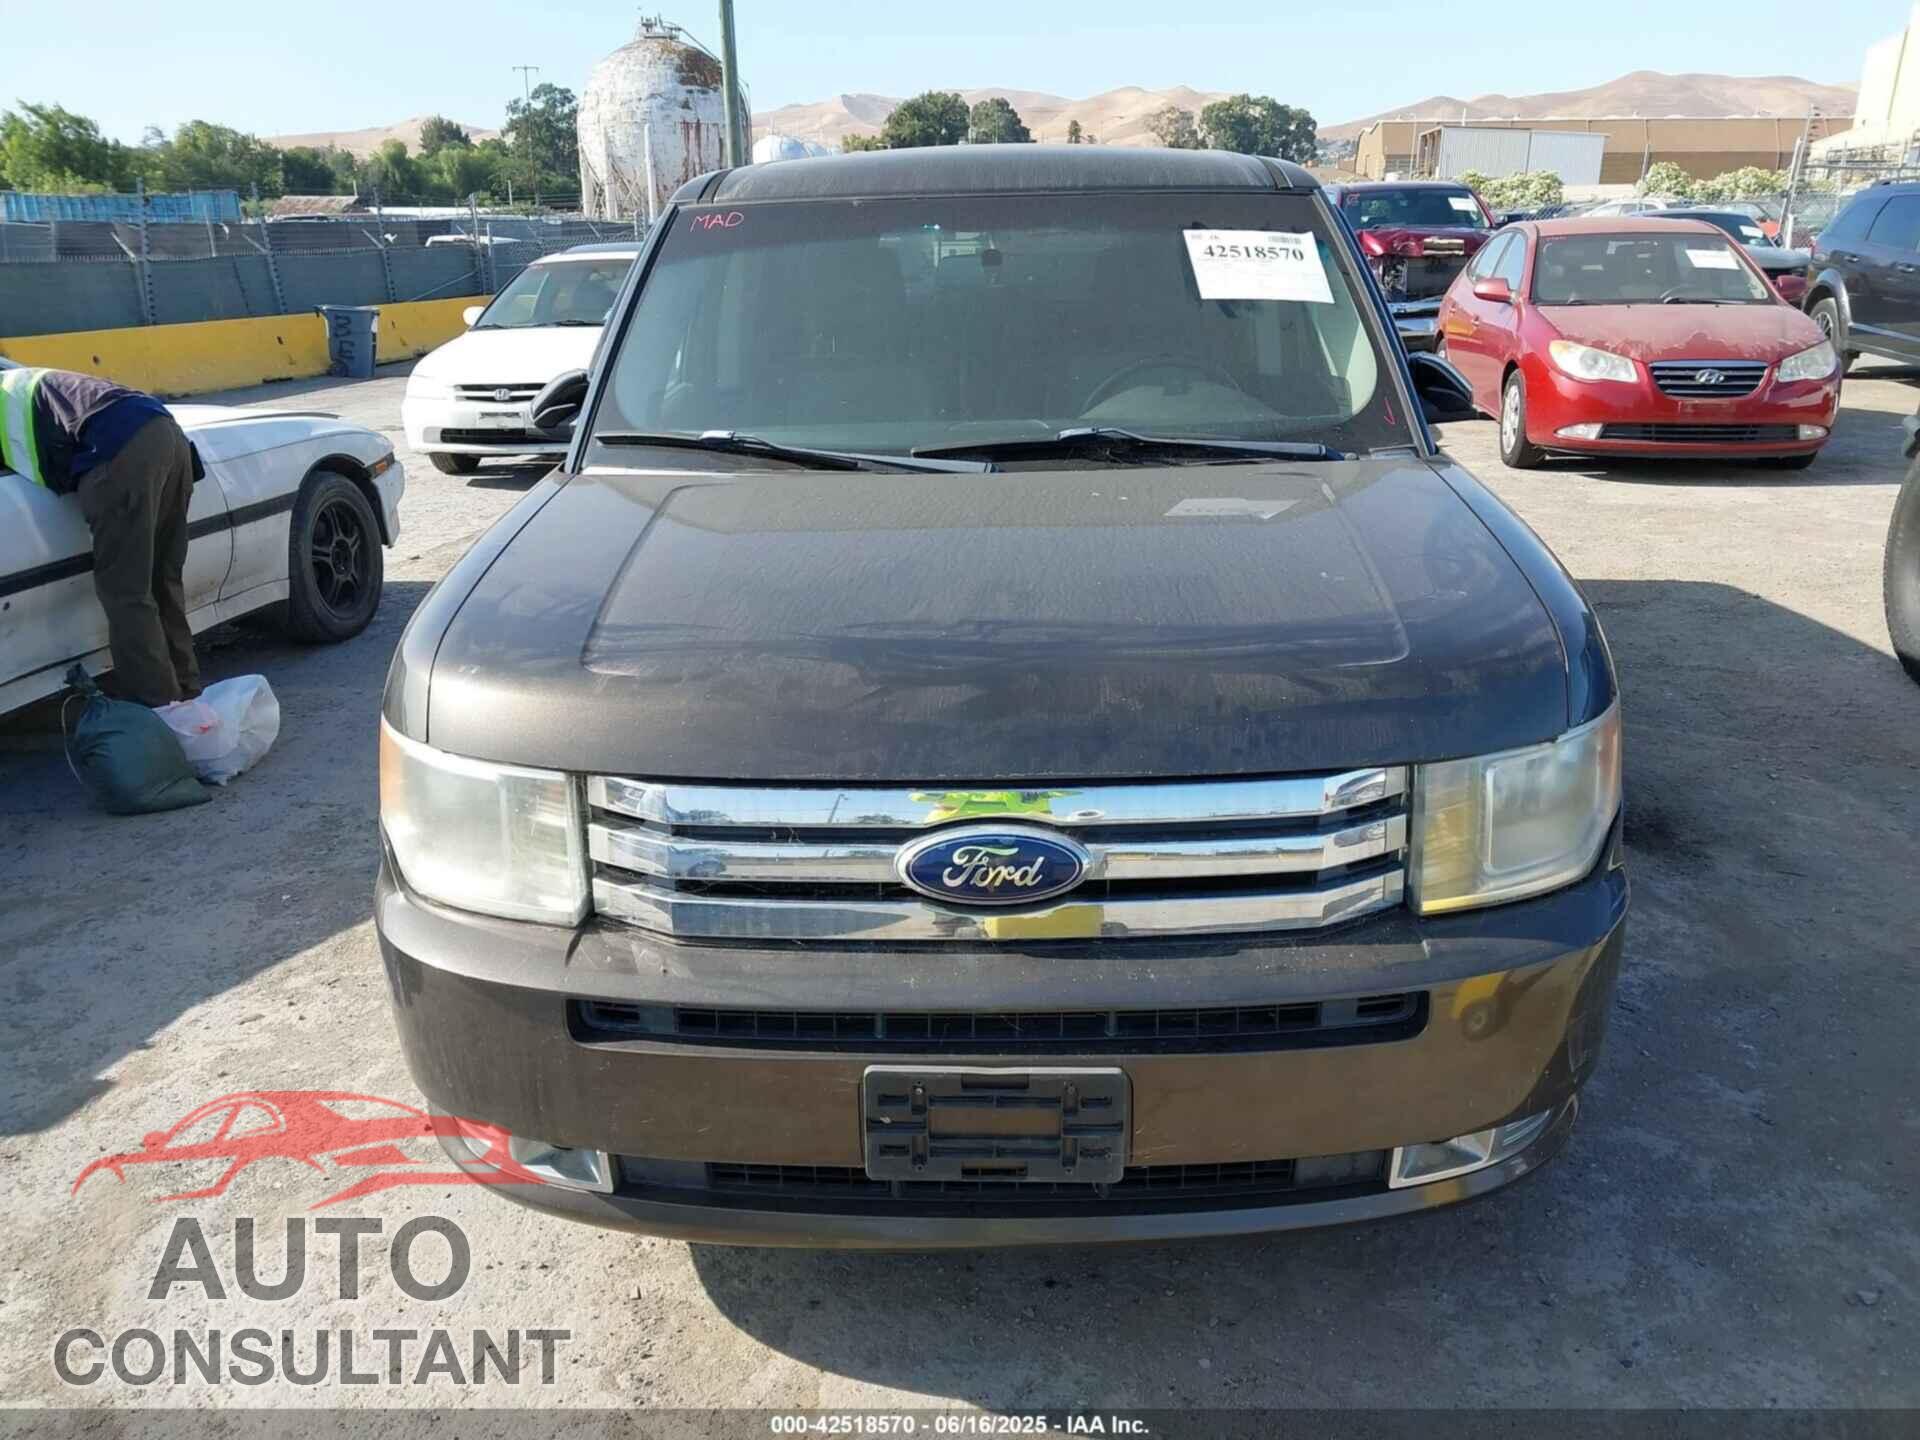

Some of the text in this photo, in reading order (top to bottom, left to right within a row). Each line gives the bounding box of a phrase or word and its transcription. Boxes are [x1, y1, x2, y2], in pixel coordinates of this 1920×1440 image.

[689, 211, 745, 233] MAD
[1203, 244, 1305, 262] 42518570
[942, 845, 1045, 888] Ford
